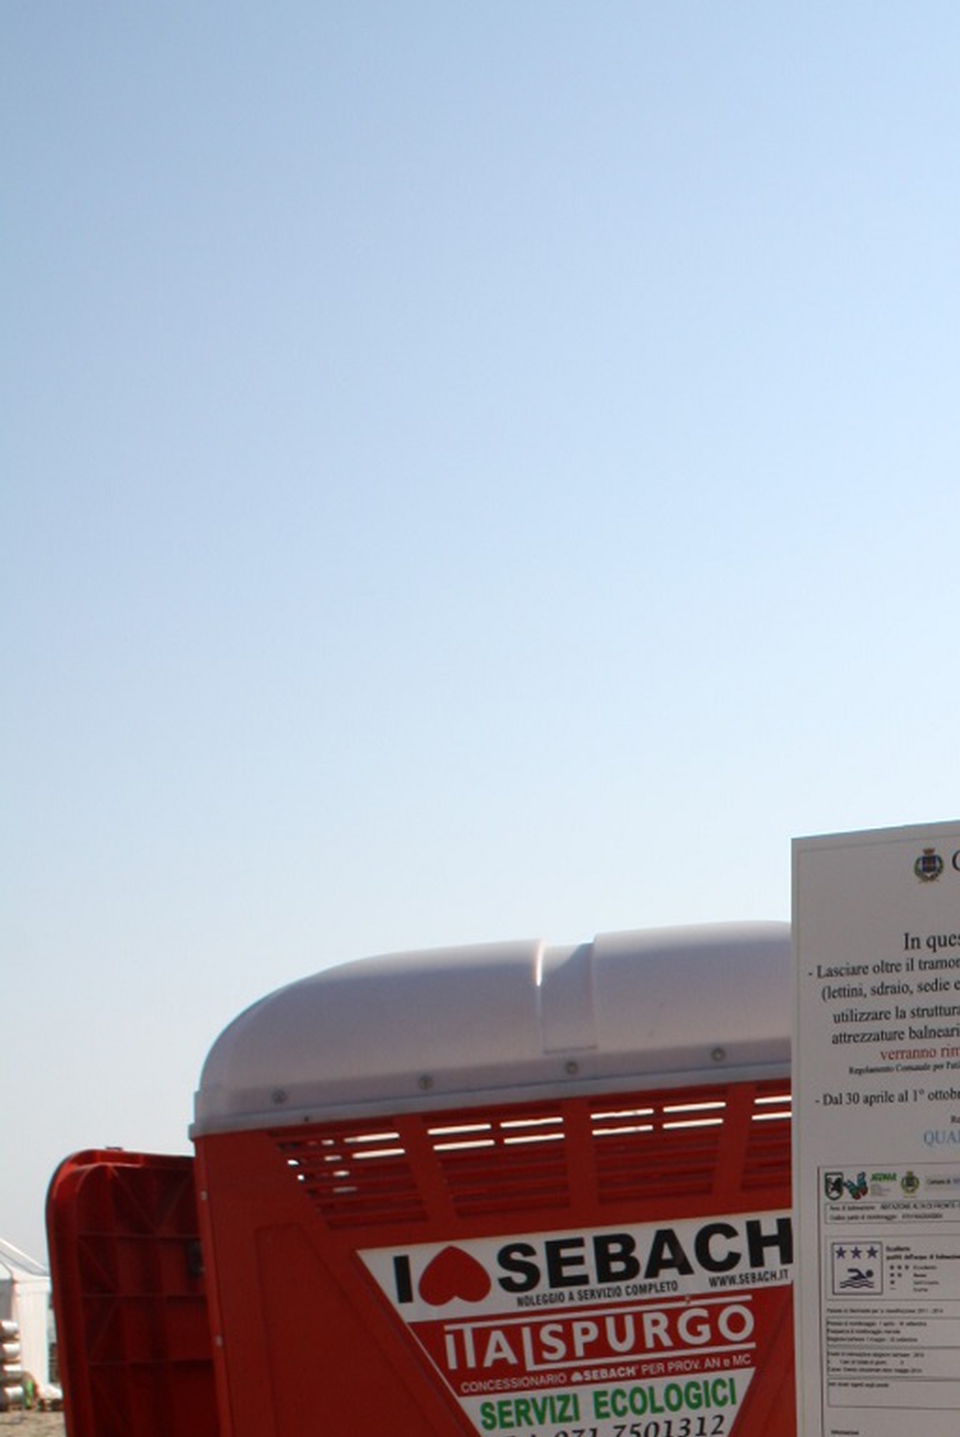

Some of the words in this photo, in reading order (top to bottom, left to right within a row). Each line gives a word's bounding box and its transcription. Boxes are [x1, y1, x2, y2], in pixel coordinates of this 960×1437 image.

[904, 932, 921, 951] In
[816, 962, 869, 979] Lasciare
[871, 959, 902, 975] oltre
[821, 982, 867, 1002] (lettini,
[870, 980, 914, 996] sdraio,
[917, 977, 950, 993] sedie
[833, 1008, 892, 1024] utilizzare
[831, 1029, 905, 1045] attrezzature
[880, 1047, 937, 1061] verranno
[862, 1090, 895, 1107] aprile
[393, 1254, 413, 1304] I
[497, 1217, 793, 1294] SEBACH
[709, 1269, 789, 1288] WWW.SEBACH.IT
[517, 1291, 566, 1308] NOLEGGIO
[577, 1285, 622, 1301] SERVIZIO
[625, 1280, 679, 1297] COMPLETO
[461, 1372, 567, 1394] CONCESSIONARIO
[641, 1363, 664, 1377] PER
[666, 1359, 701, 1375] PROV.
[704, 1357, 721, 1370] AN
[732, 1354, 751, 1367] MC
[479, 1392, 579, 1431] SERVIZI
[594, 1377, 737, 1420] ECOLOGICI
